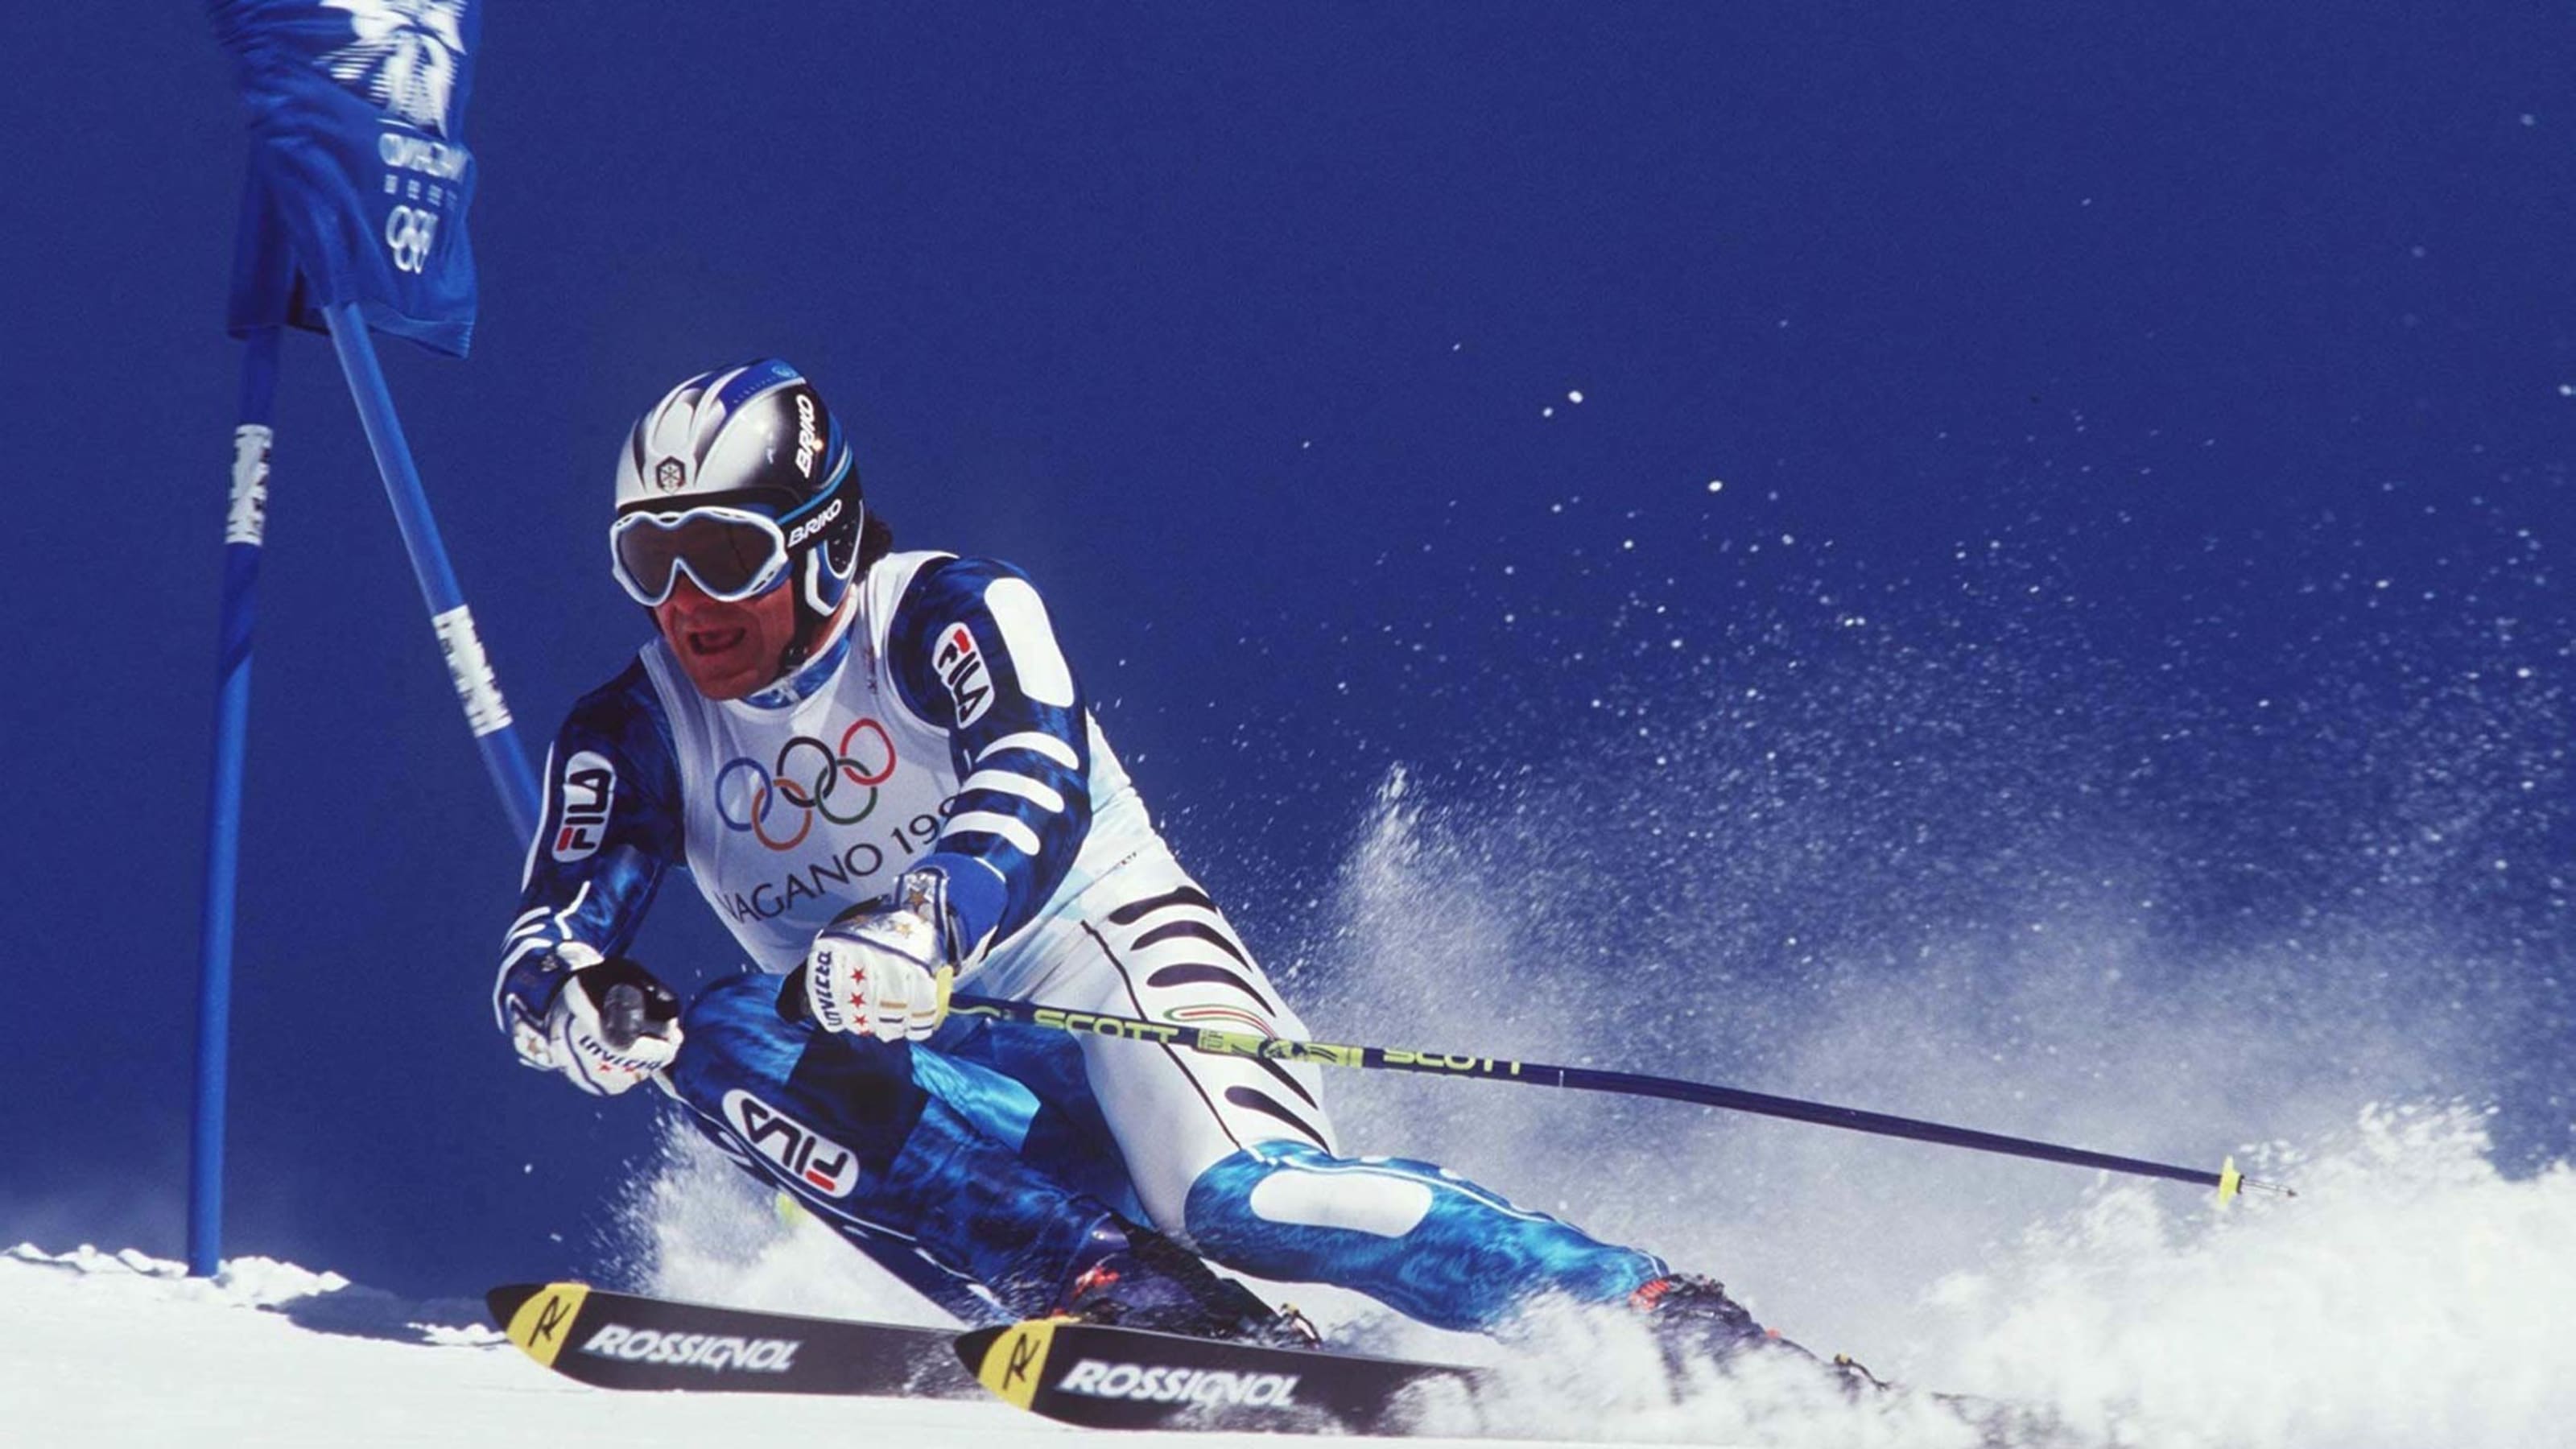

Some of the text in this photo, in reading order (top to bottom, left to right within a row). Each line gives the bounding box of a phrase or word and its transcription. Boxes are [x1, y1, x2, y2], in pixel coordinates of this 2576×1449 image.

[795, 394, 815, 478] BRIKO
[787, 498, 842, 547] BRIKO
[938, 629, 989, 723] FILA
[556, 769, 612, 852] FILA
[1034, 1009, 1179, 1044] SCOTT
[741, 1098, 848, 1192] FILA
[584, 1323, 799, 1373] ROSSIGNOL
[1059, 1358, 1300, 1409] ROSSIGNOL
